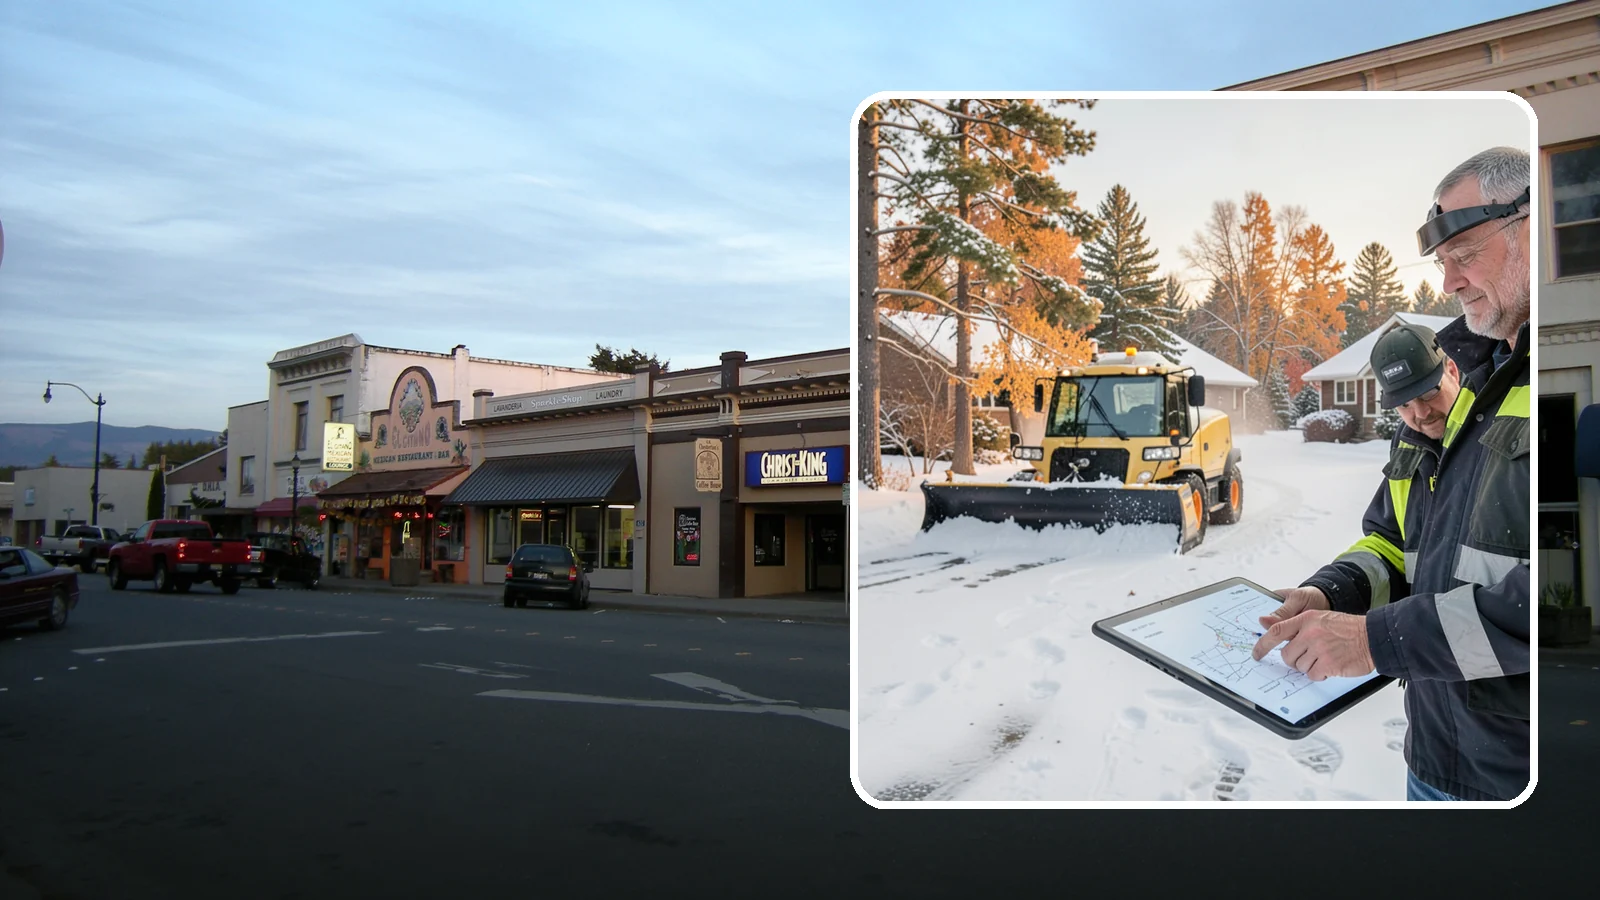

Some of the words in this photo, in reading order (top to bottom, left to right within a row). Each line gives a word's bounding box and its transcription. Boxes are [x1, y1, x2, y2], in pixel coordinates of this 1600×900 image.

[595, 389, 623, 400] LAUNDRY
[493, 402, 523, 413] LAVANDERIA
[530, 396, 560, 409] Sparkle
[561, 395, 582, 405] Shop
[373, 455, 396, 464] MEXICAN
[397, 451, 433, 462] RESTAURANT
[438, 450, 450, 458] BAR
[761, 452, 797, 478] CHRIST
[799, 450, 827, 476] KING
